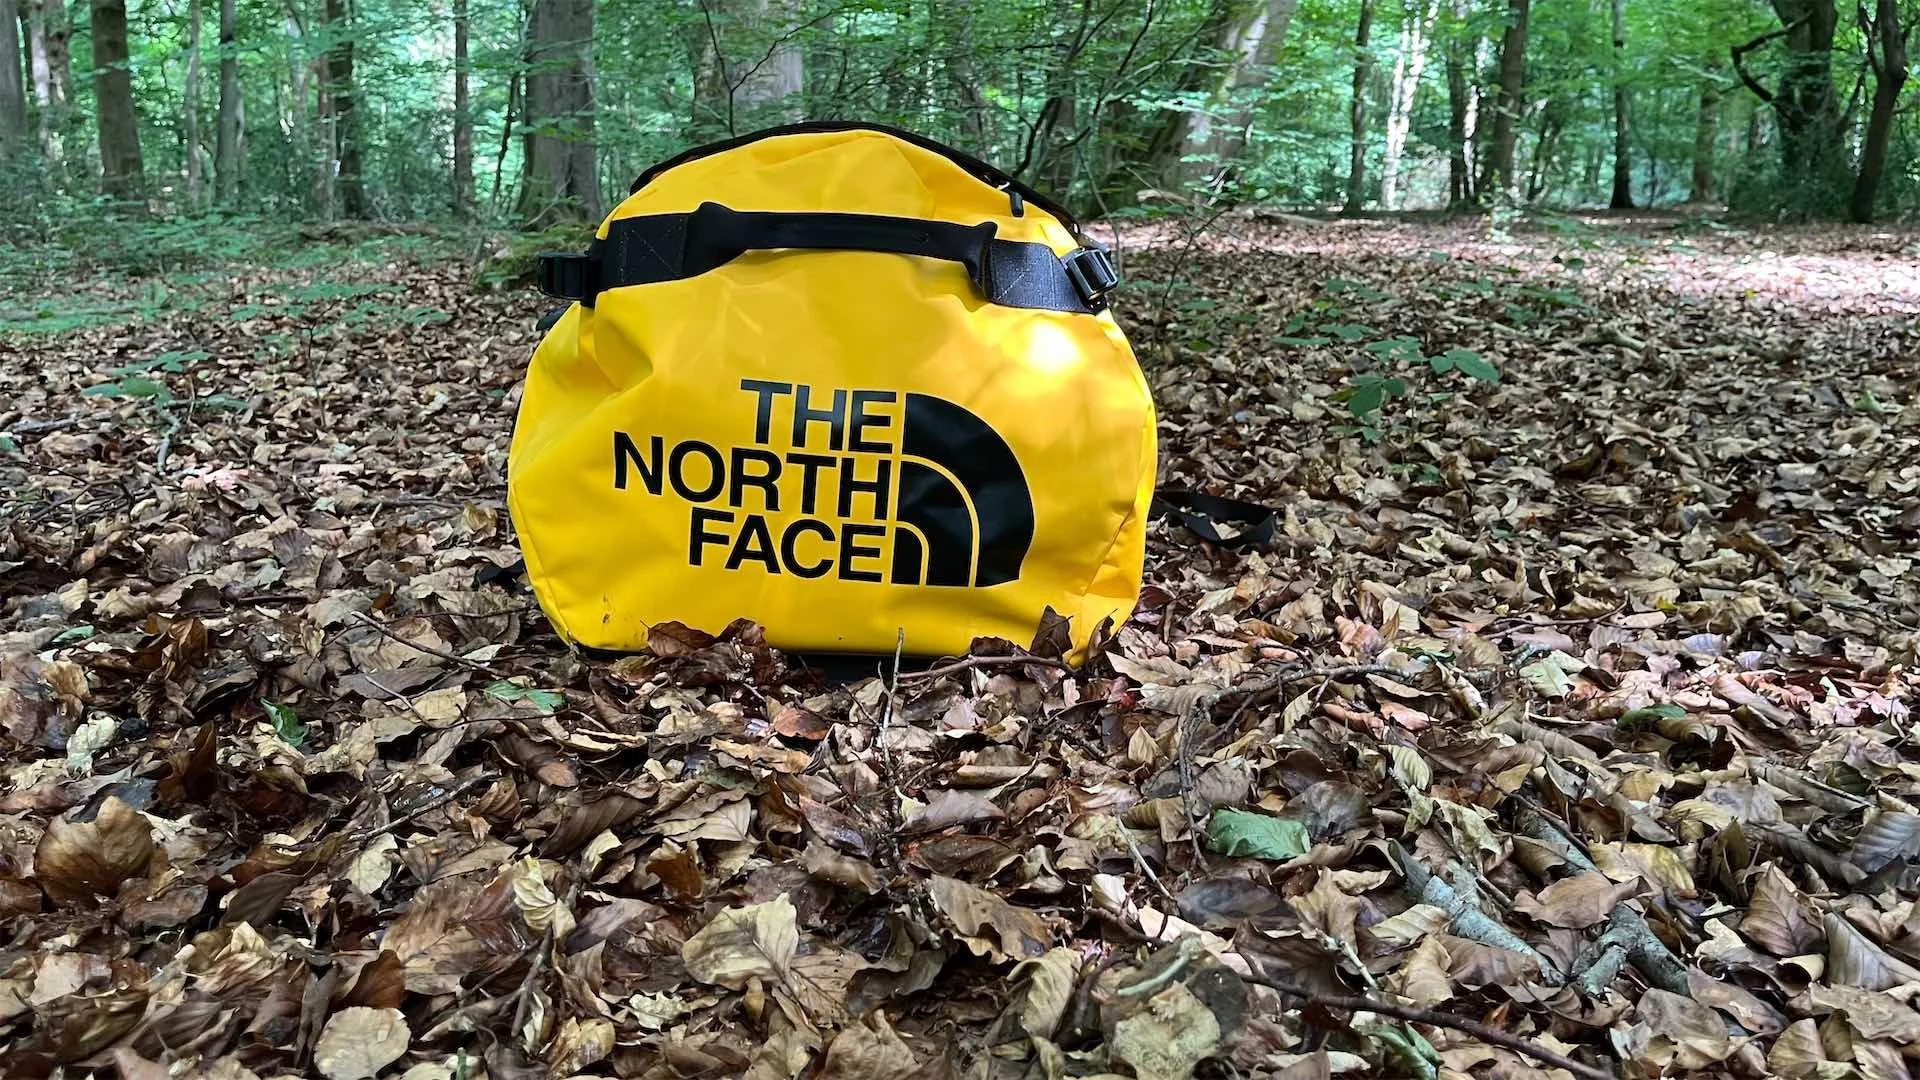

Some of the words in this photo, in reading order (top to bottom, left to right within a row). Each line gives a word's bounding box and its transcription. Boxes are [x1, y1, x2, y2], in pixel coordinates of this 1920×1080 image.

[740, 378, 897, 454] THE
[613, 430, 892, 521] NORTH
[688, 506, 883, 583] FACE
